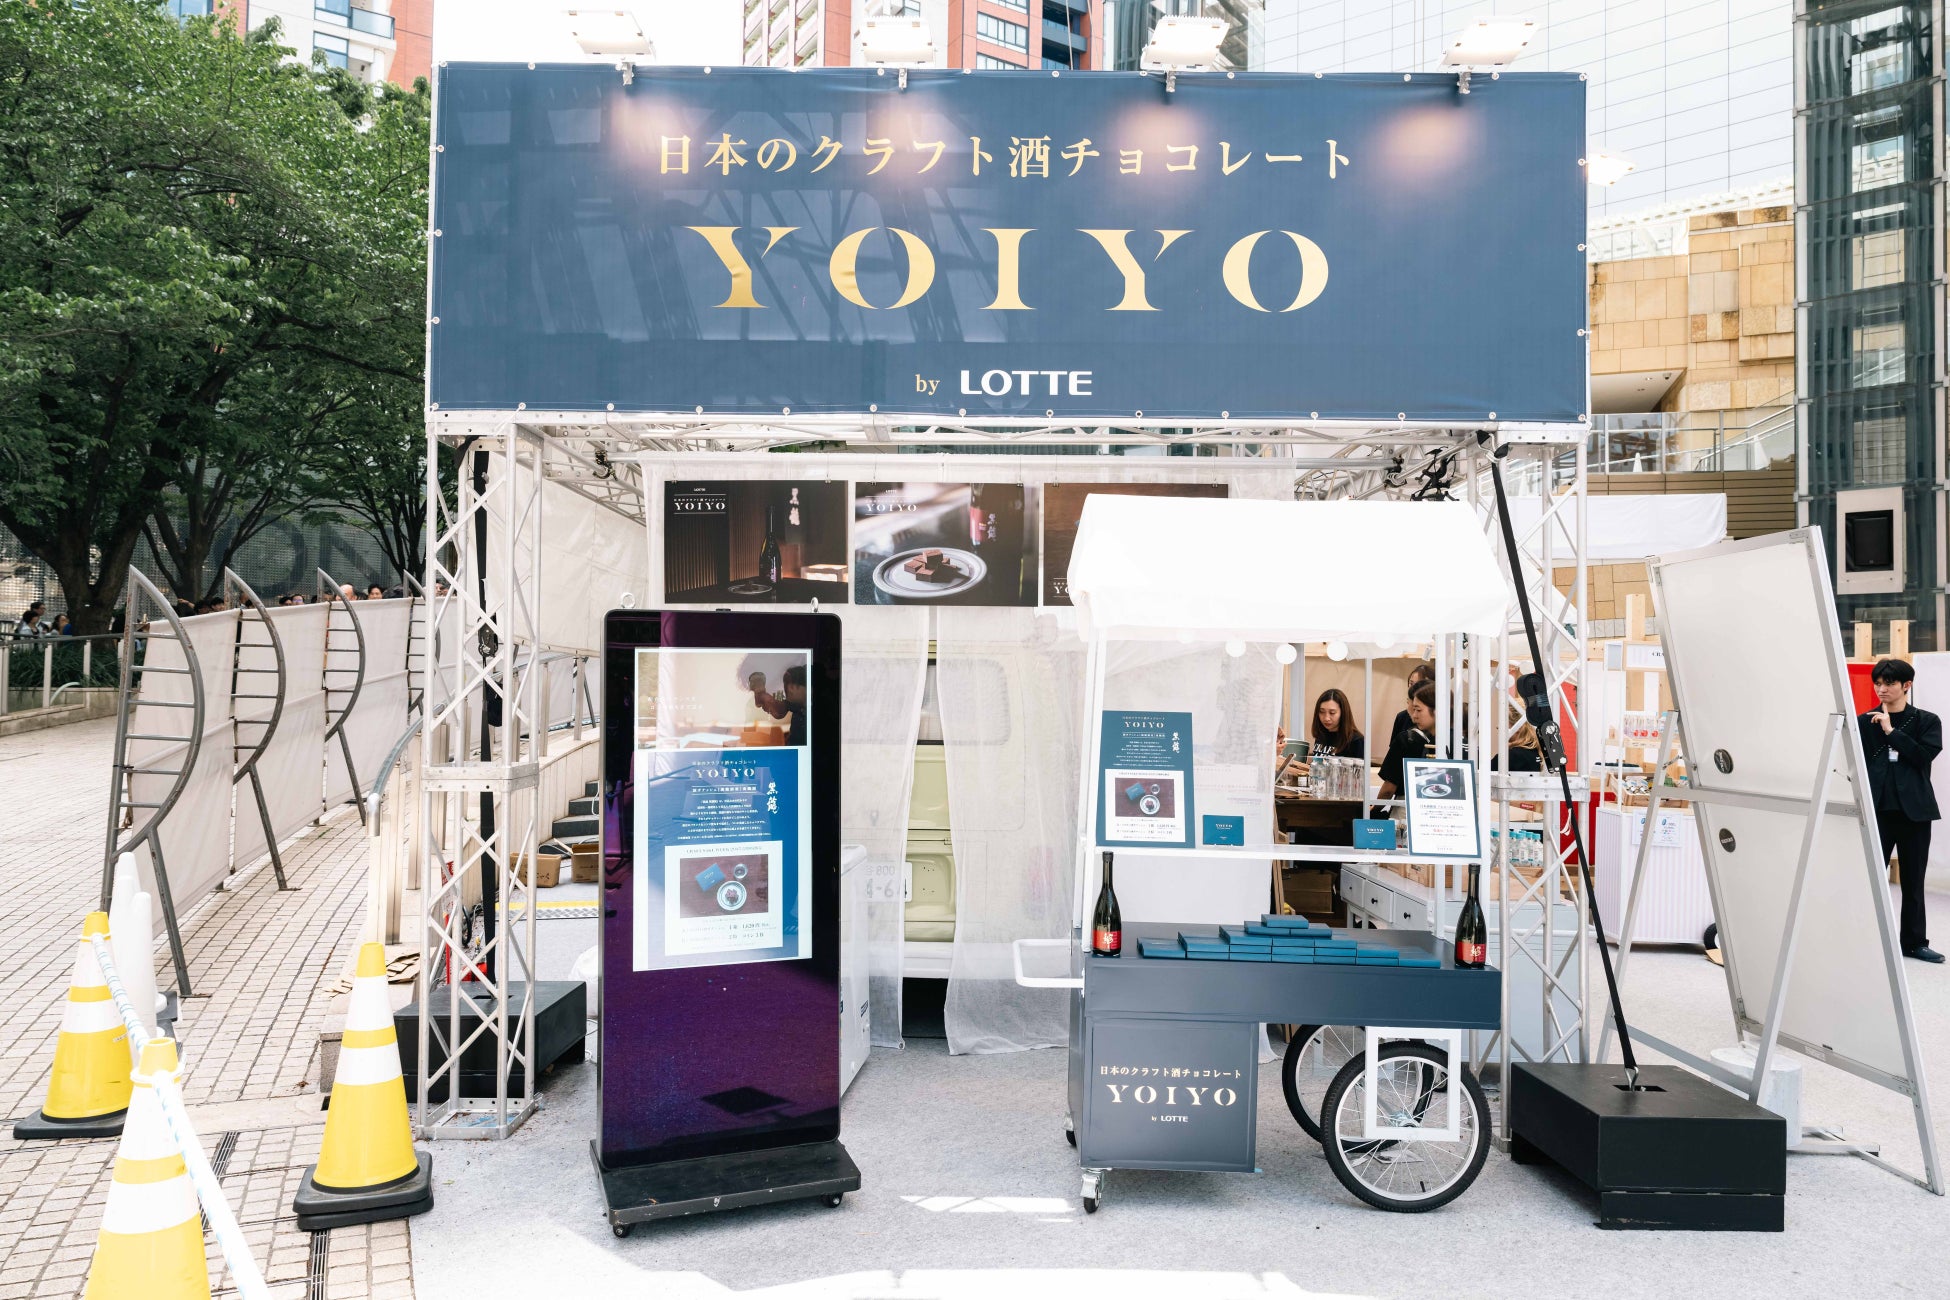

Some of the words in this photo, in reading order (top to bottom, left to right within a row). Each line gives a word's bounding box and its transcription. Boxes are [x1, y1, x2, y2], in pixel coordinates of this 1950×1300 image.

[659, 133, 1350, 179] 日本のクラフト酒チョコレート
[687, 226, 1331, 312] YOIYO
[915, 373, 941, 397] by
[959, 369, 1093, 396] LOTTE
[674, 502, 726, 511] YOIYO
[866, 504, 917, 512] YOIYO
[1125, 721, 1164, 729] YOIYO
[696, 768, 755, 779] YOIYO
[1100, 1065, 1242, 1079] 日本のクラフト酒チョコレート
[1106, 1084, 1237, 1106] YOIYO
[1160, 1115, 1189, 1123] LOTTE
